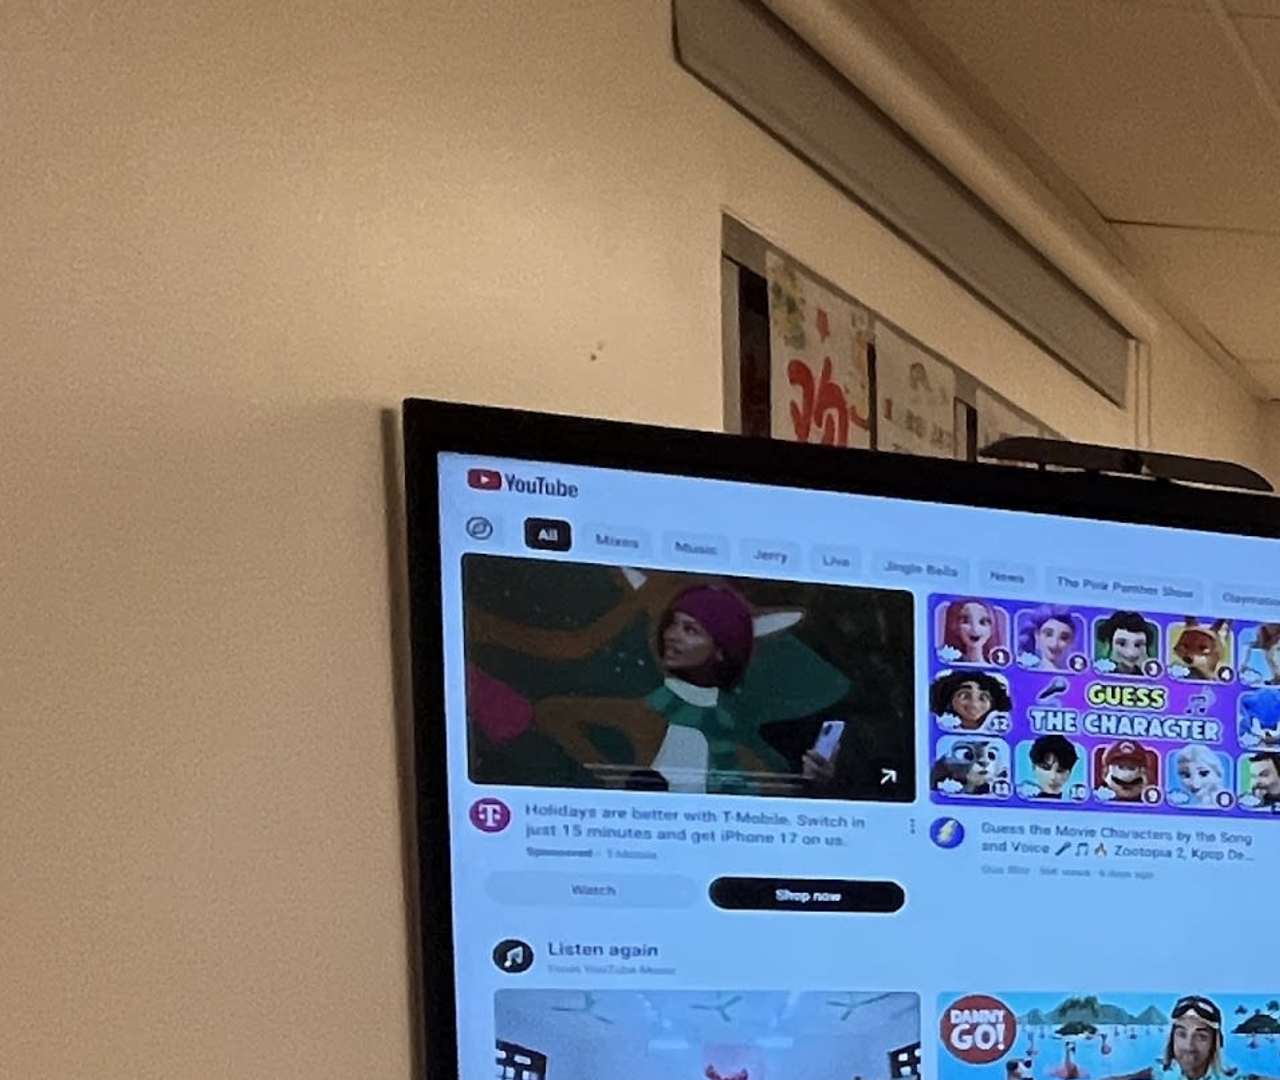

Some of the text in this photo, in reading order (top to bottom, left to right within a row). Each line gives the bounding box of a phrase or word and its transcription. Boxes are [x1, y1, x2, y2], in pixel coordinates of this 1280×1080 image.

[504, 473, 578, 498] YouTube
[538, 528, 557, 542] All
[754, 549, 788, 565] Jerry
[823, 555, 850, 568] Live
[885, 561, 959, 578] Jingle Bells
[990, 571, 1024, 584] News
[1057, 576, 1079, 589] The
[1162, 585, 1193, 599] Show
[996, 651, 1004, 664] 1
[1088, 685, 1166, 708] GUESS
[1030, 711, 1221, 741] THE CHARACTER
[526, 803, 597, 820] Holidays
[602, 807, 627, 819] are
[631, 806, 679, 821] better
[684, 810, 717, 823] with
[797, 814, 848, 828] Switch
[852, 815, 865, 828] in
[525, 824, 556, 839] just
[563, 824, 583, 837] 15
[586, 825, 653, 840] minutes
[657, 828, 687, 841] and
[691, 831, 716, 845] get
[721, 829, 774, 844] iPhone
[780, 831, 799, 844] 17
[802, 835, 821, 846] on
[981, 821, 1253, 847] Guess the Movie Characters by the Song
[981, 840, 1008, 854] and
[1011, 840, 1050, 855] Voice
[1114, 844, 1173, 861] Zootopia
[1191, 847, 1225, 863] Kpop
[571, 884, 617, 896] Watch
[775, 889, 842, 904] Shop now
[548, 942, 659, 960] Listen again
[950, 1009, 1005, 1024] DANNY
[950, 1023, 1005, 1050] GO!
